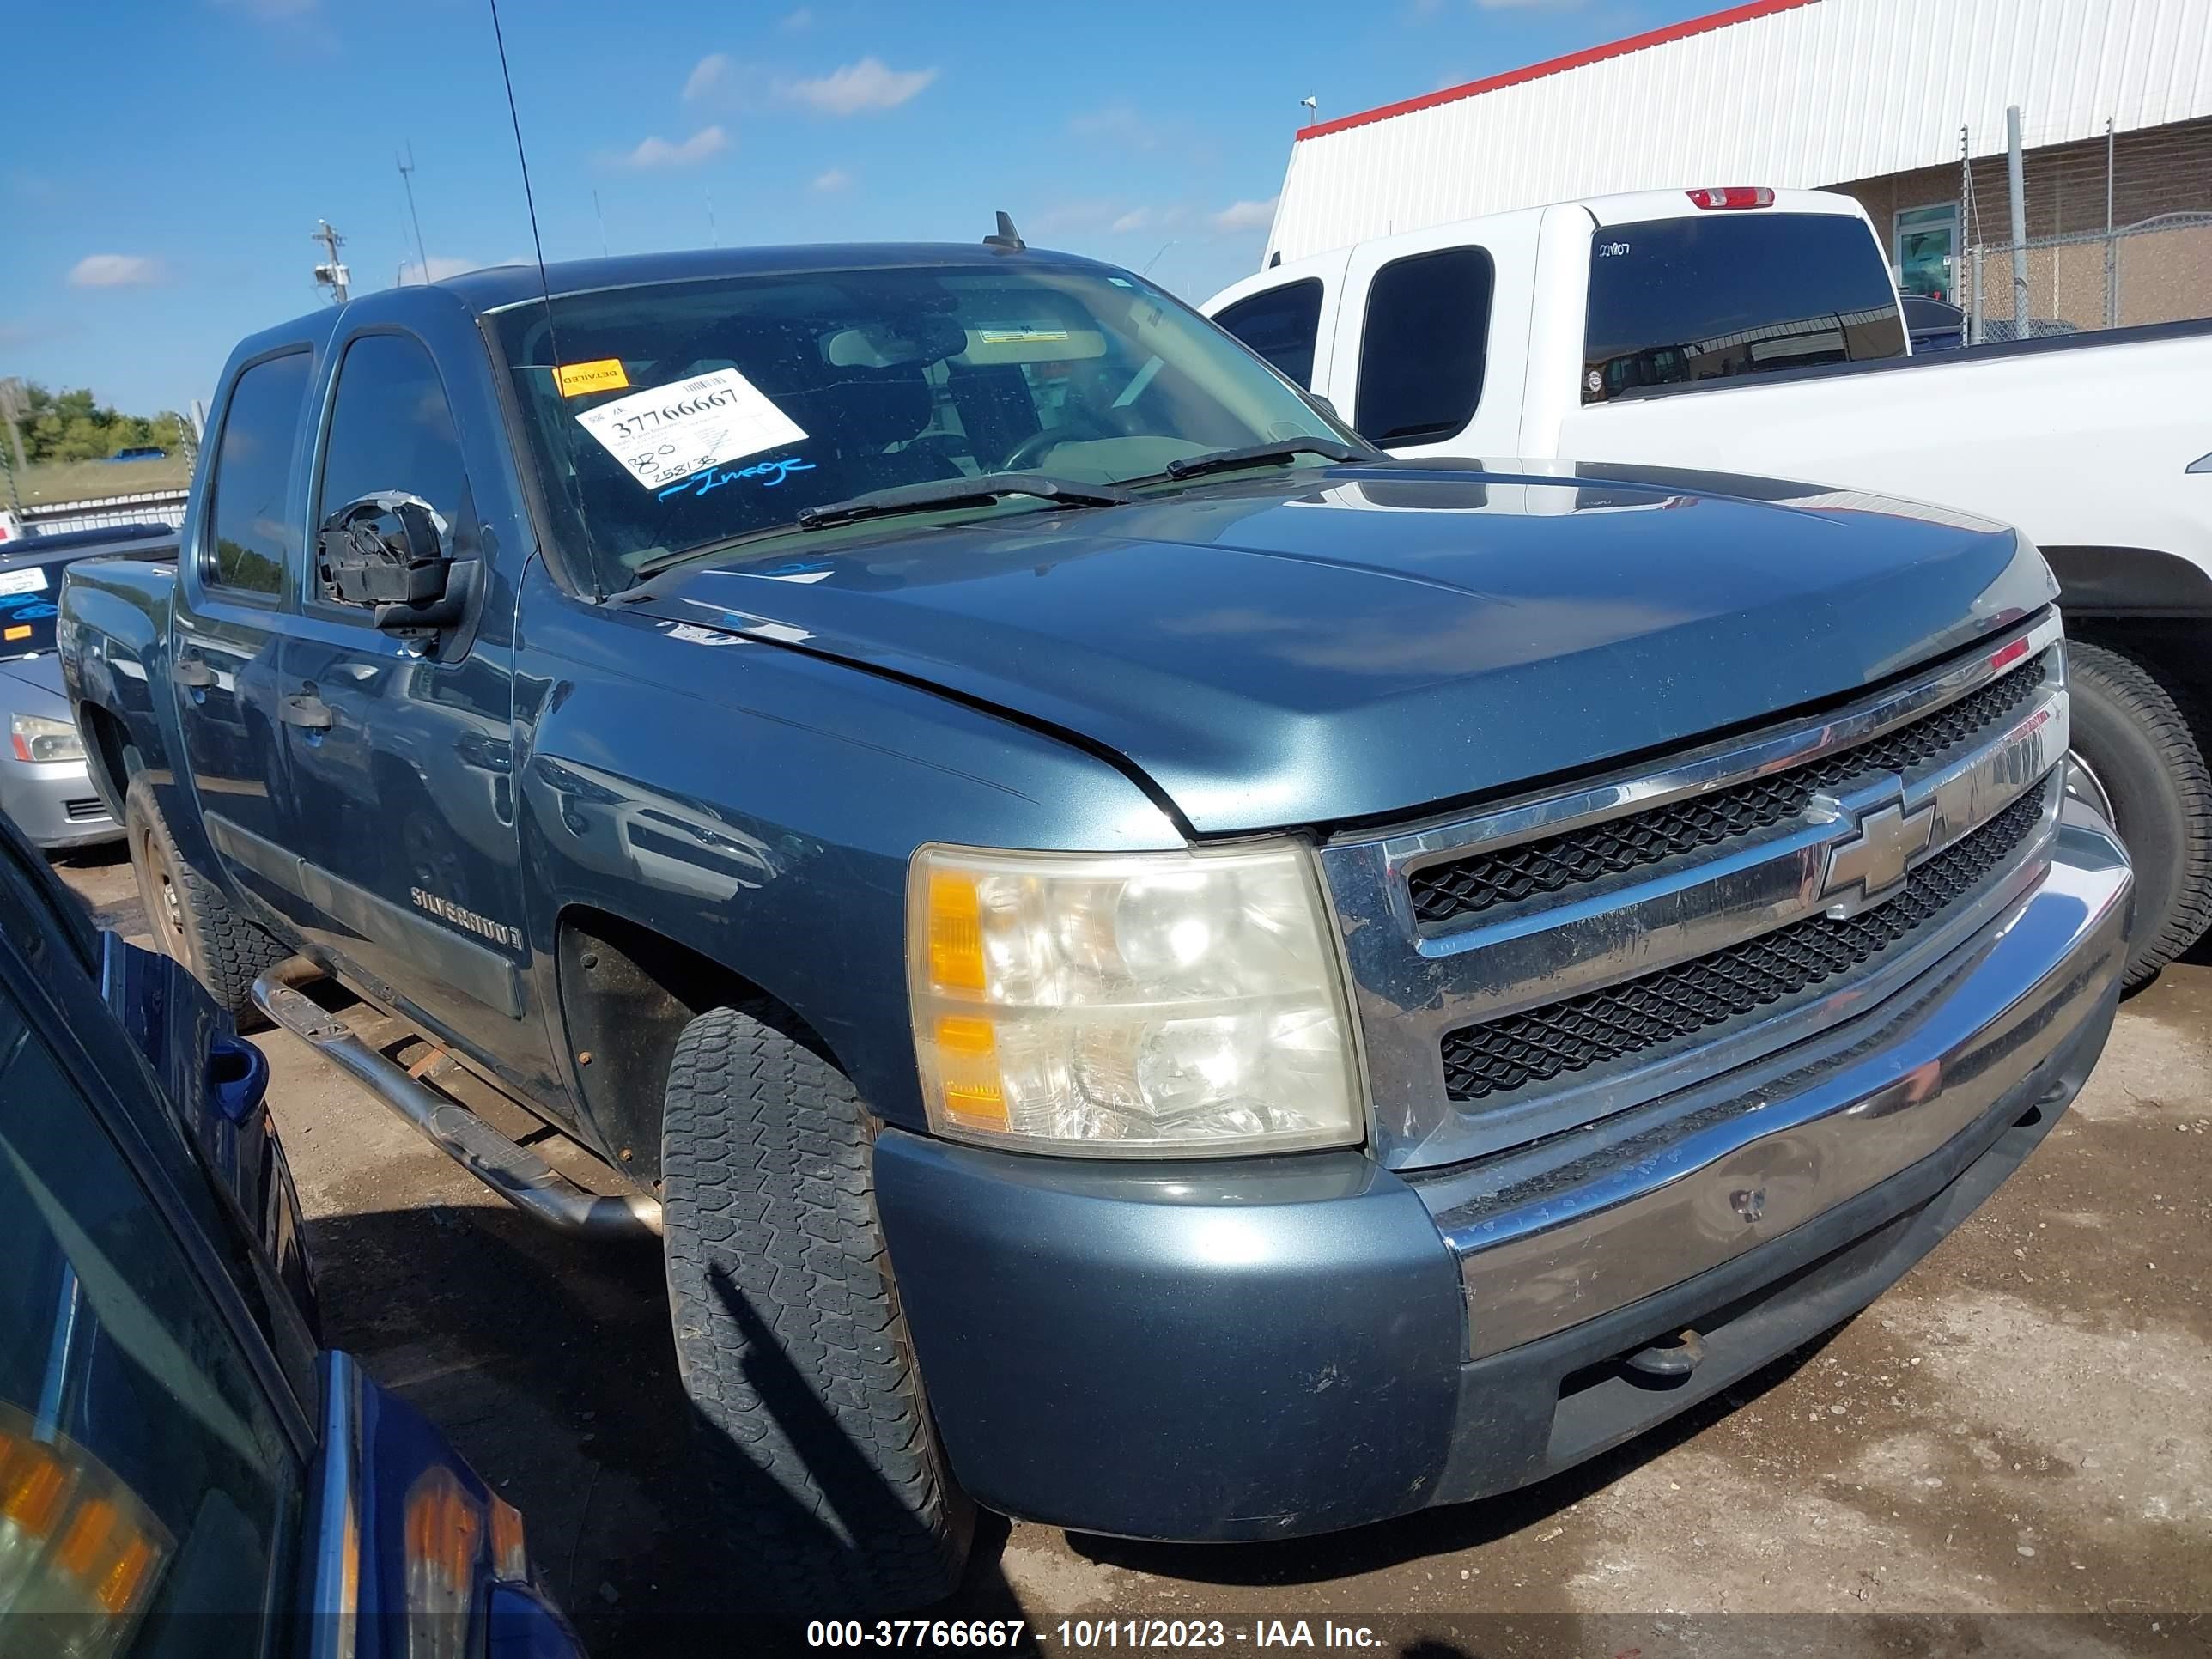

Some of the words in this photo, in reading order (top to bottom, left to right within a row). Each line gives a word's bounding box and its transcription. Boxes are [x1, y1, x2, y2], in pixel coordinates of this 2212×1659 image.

[562, 369, 618, 385] DETAILED
[611, 388, 738, 439] 37766667
[410, 886, 510, 945] SILVERADO
